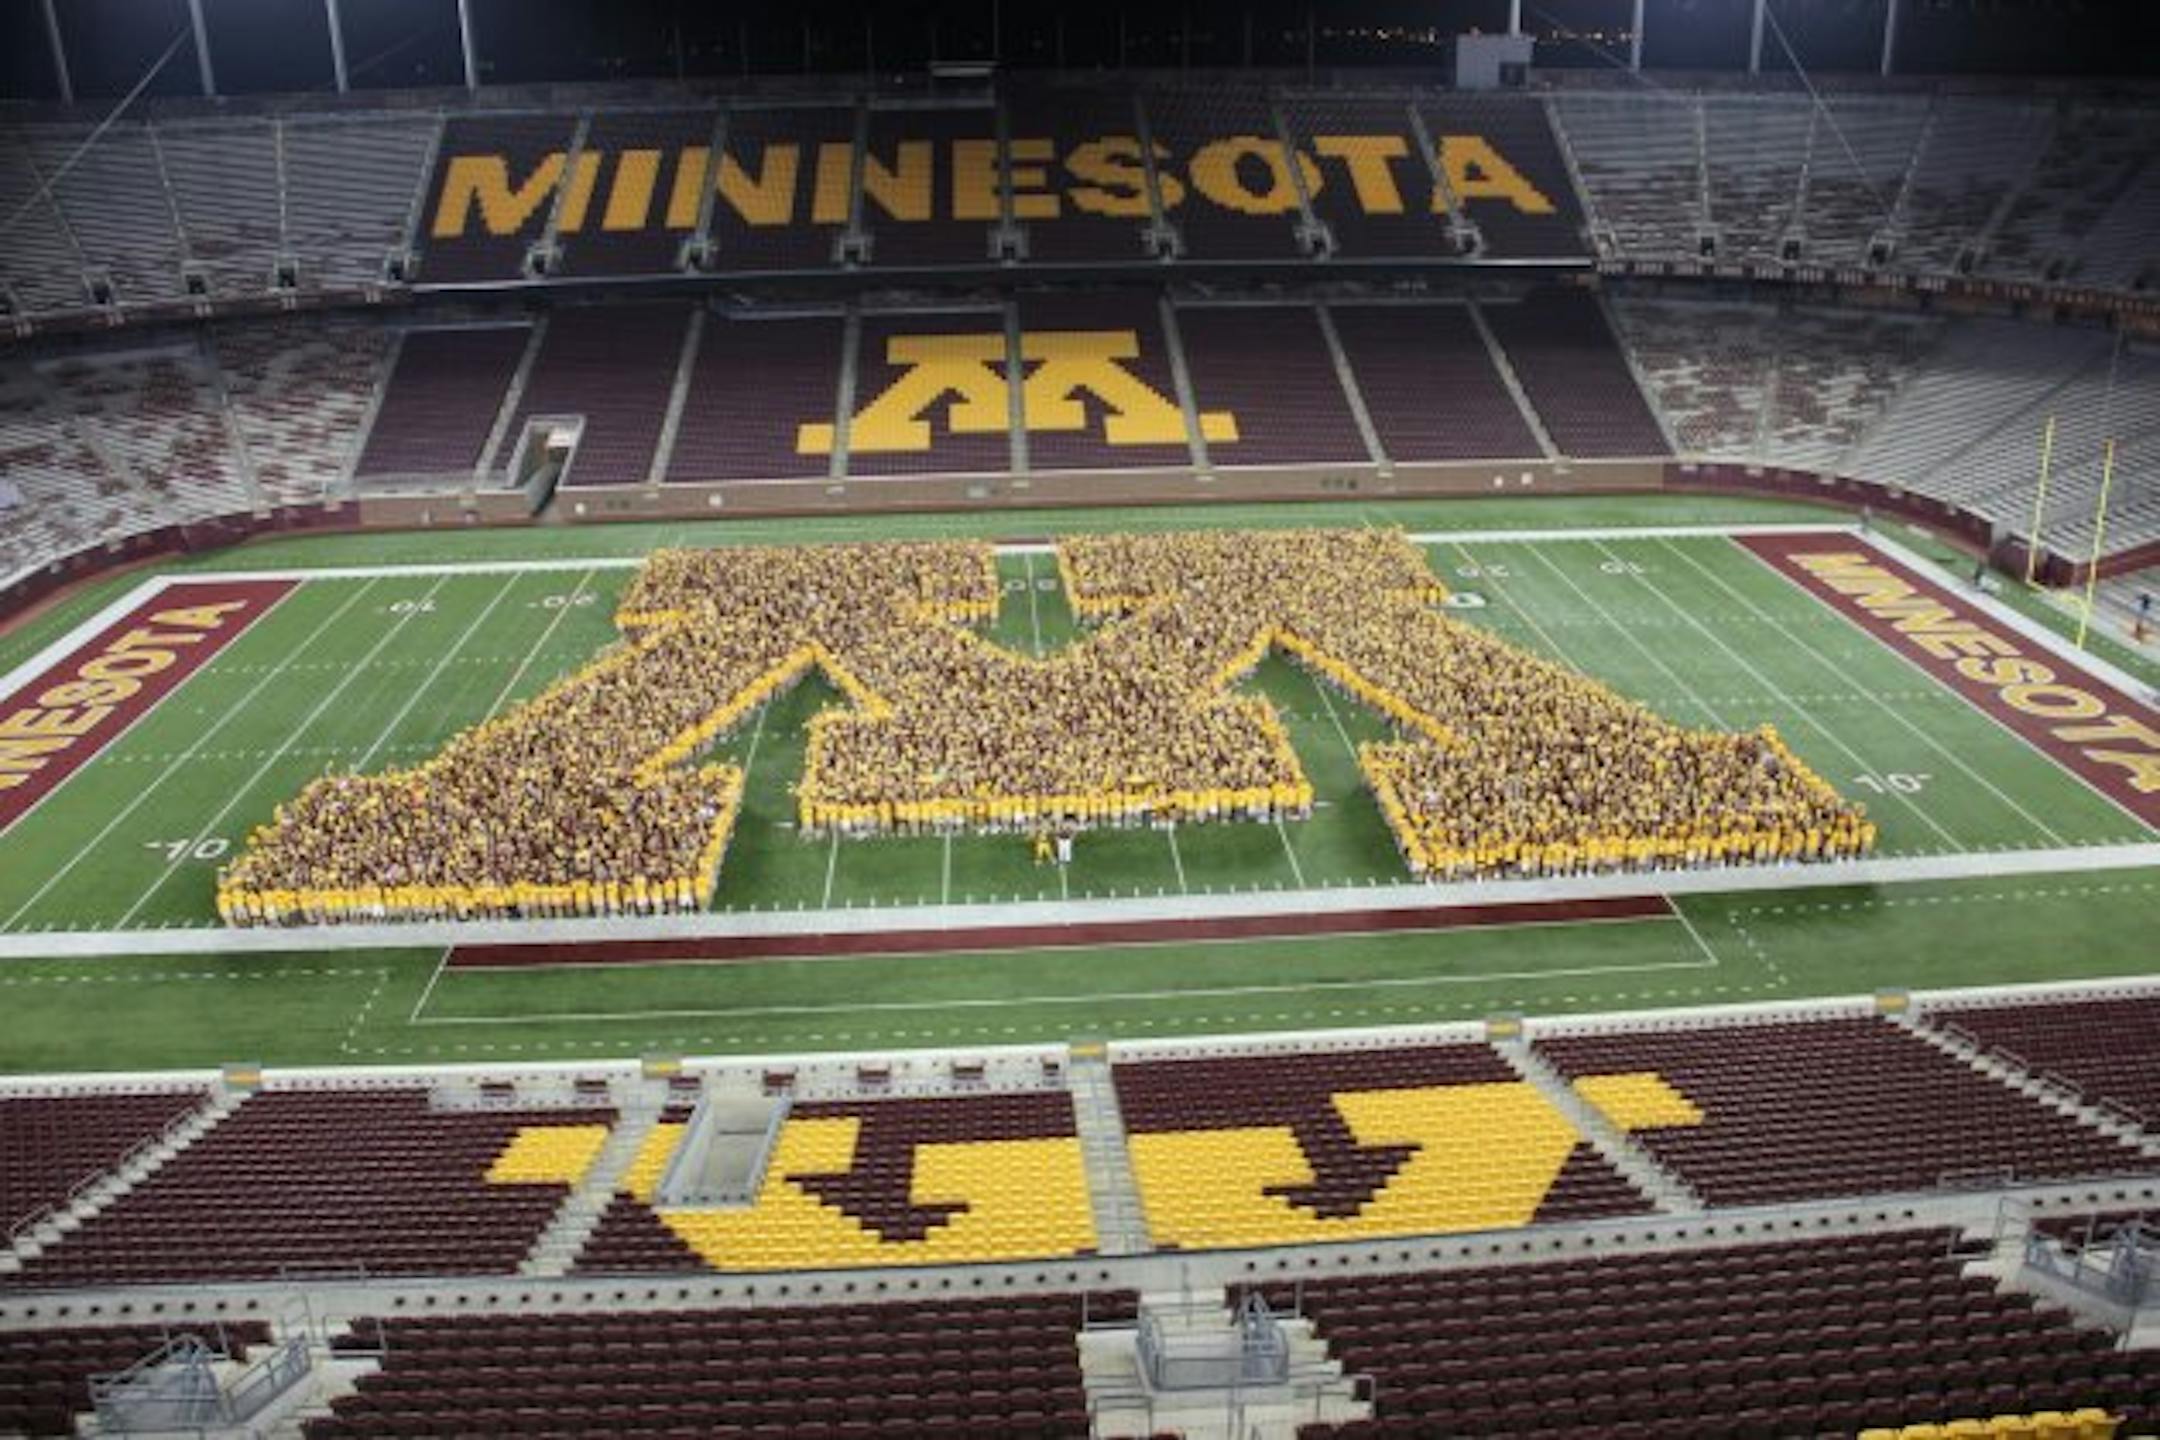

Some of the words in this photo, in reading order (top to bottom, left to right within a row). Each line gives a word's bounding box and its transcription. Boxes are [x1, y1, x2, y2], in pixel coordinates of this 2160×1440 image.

[432, 134, 1556, 239] MINNESOTA
[796, 330, 1239, 453] M
[217, 527, 1877, 926] M
[1852, 773, 1921, 793] 10
[165, 839, 229, 859] 10
